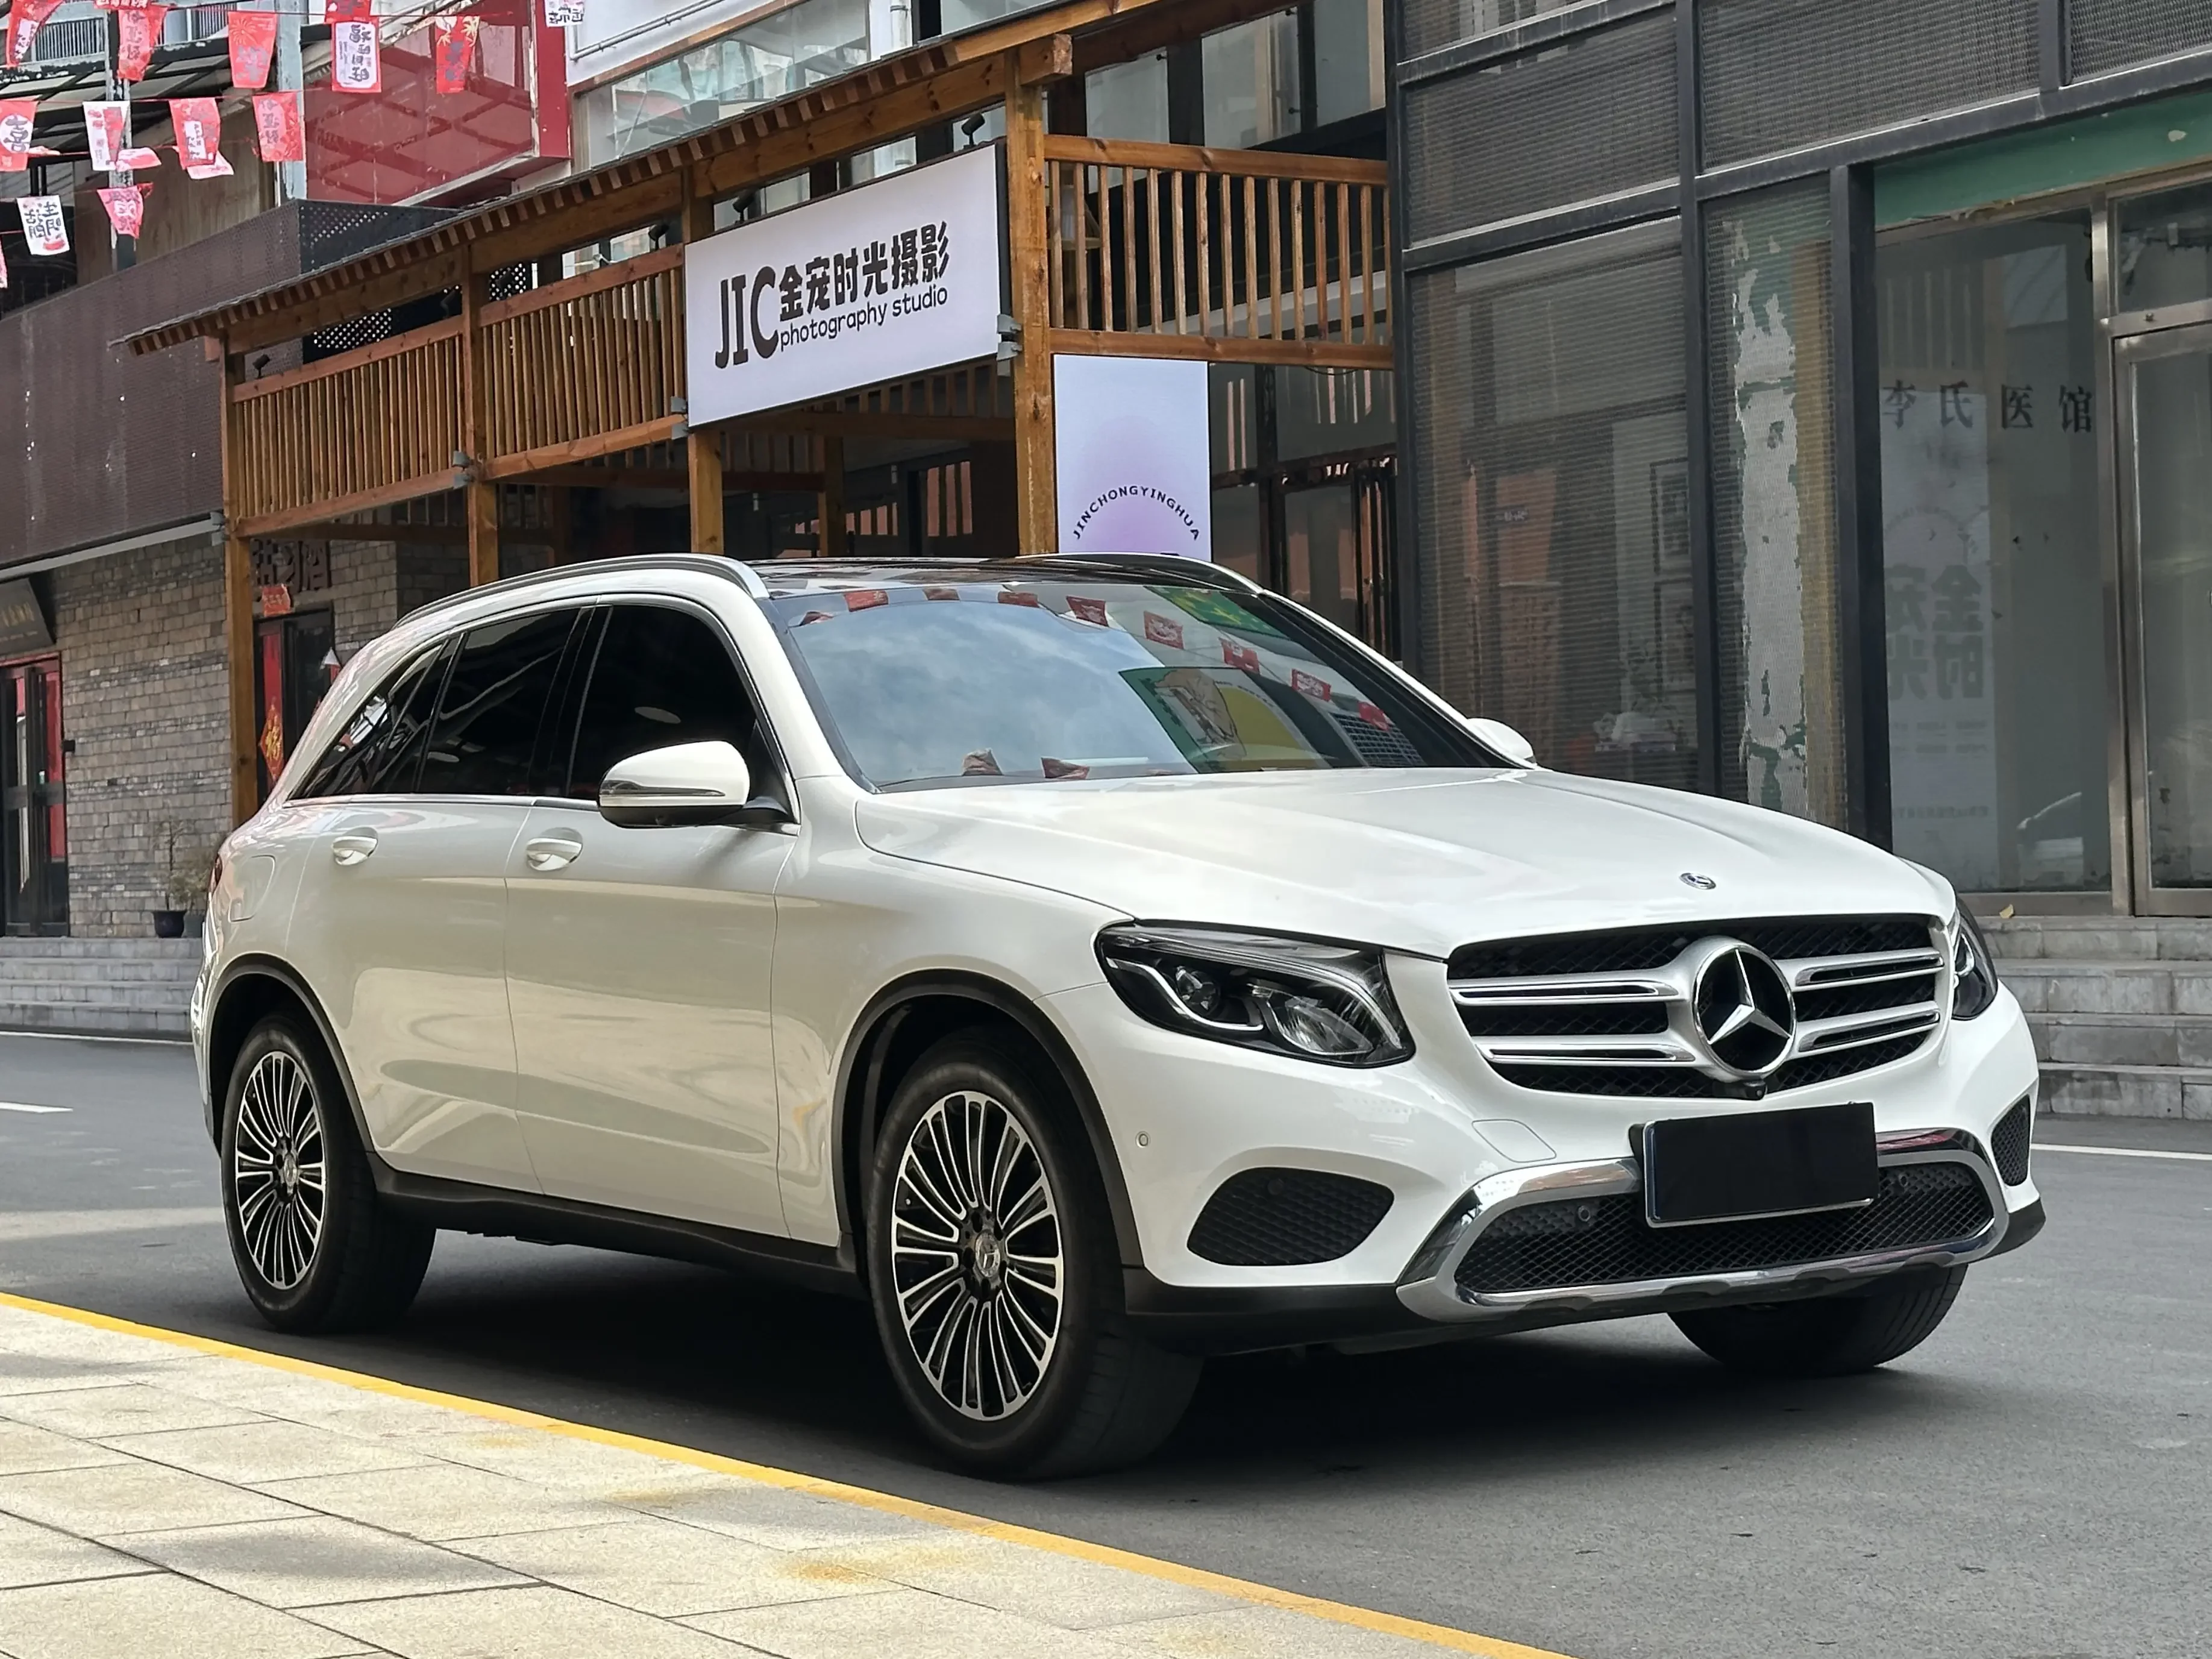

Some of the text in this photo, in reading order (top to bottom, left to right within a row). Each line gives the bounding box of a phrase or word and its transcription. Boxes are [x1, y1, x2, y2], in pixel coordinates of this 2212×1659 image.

[779, 221, 950, 322] 金宠时光摄影
[715, 266, 779, 369] JIC
[780, 283, 948, 351] photography studio
[1882, 379, 2093, 434] 李氏医馆
[1073, 485, 1200, 541] JINCHONGYINGHUA
